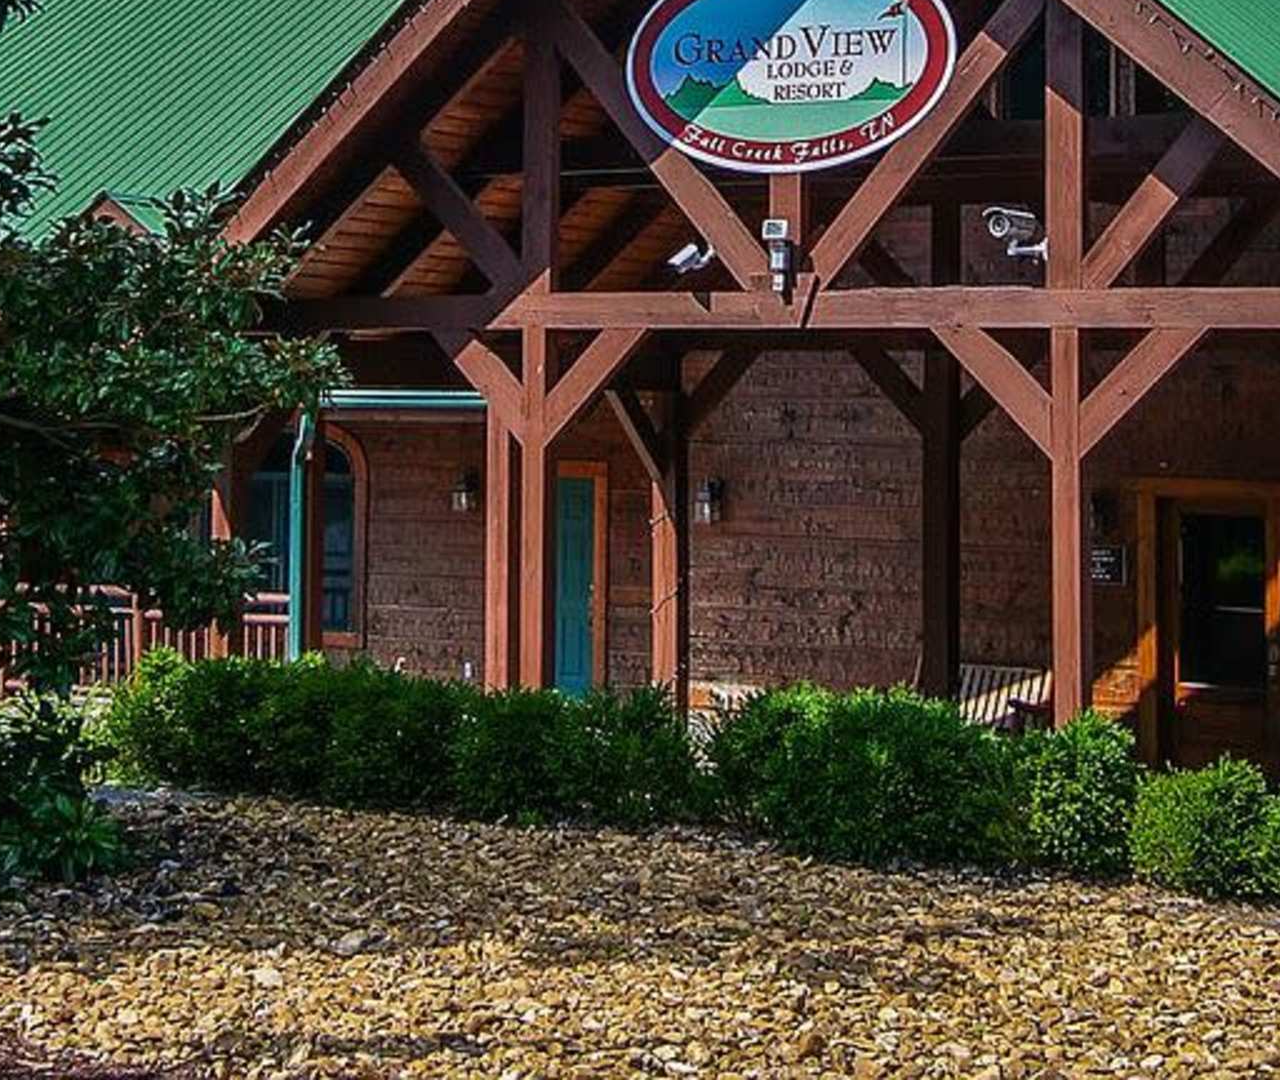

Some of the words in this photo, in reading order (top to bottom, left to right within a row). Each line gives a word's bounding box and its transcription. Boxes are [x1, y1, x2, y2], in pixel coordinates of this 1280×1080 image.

[674, 31, 796, 66] GRAND
[801, 24, 898, 58] VIEW
[767, 60, 835, 80] LODGE
[839, 59, 854, 76] &
[773, 82, 846, 101] RESORT
[682, 123, 724, 151] Fall
[732, 143, 785, 161] Creek
[860, 112, 895, 141] TN
